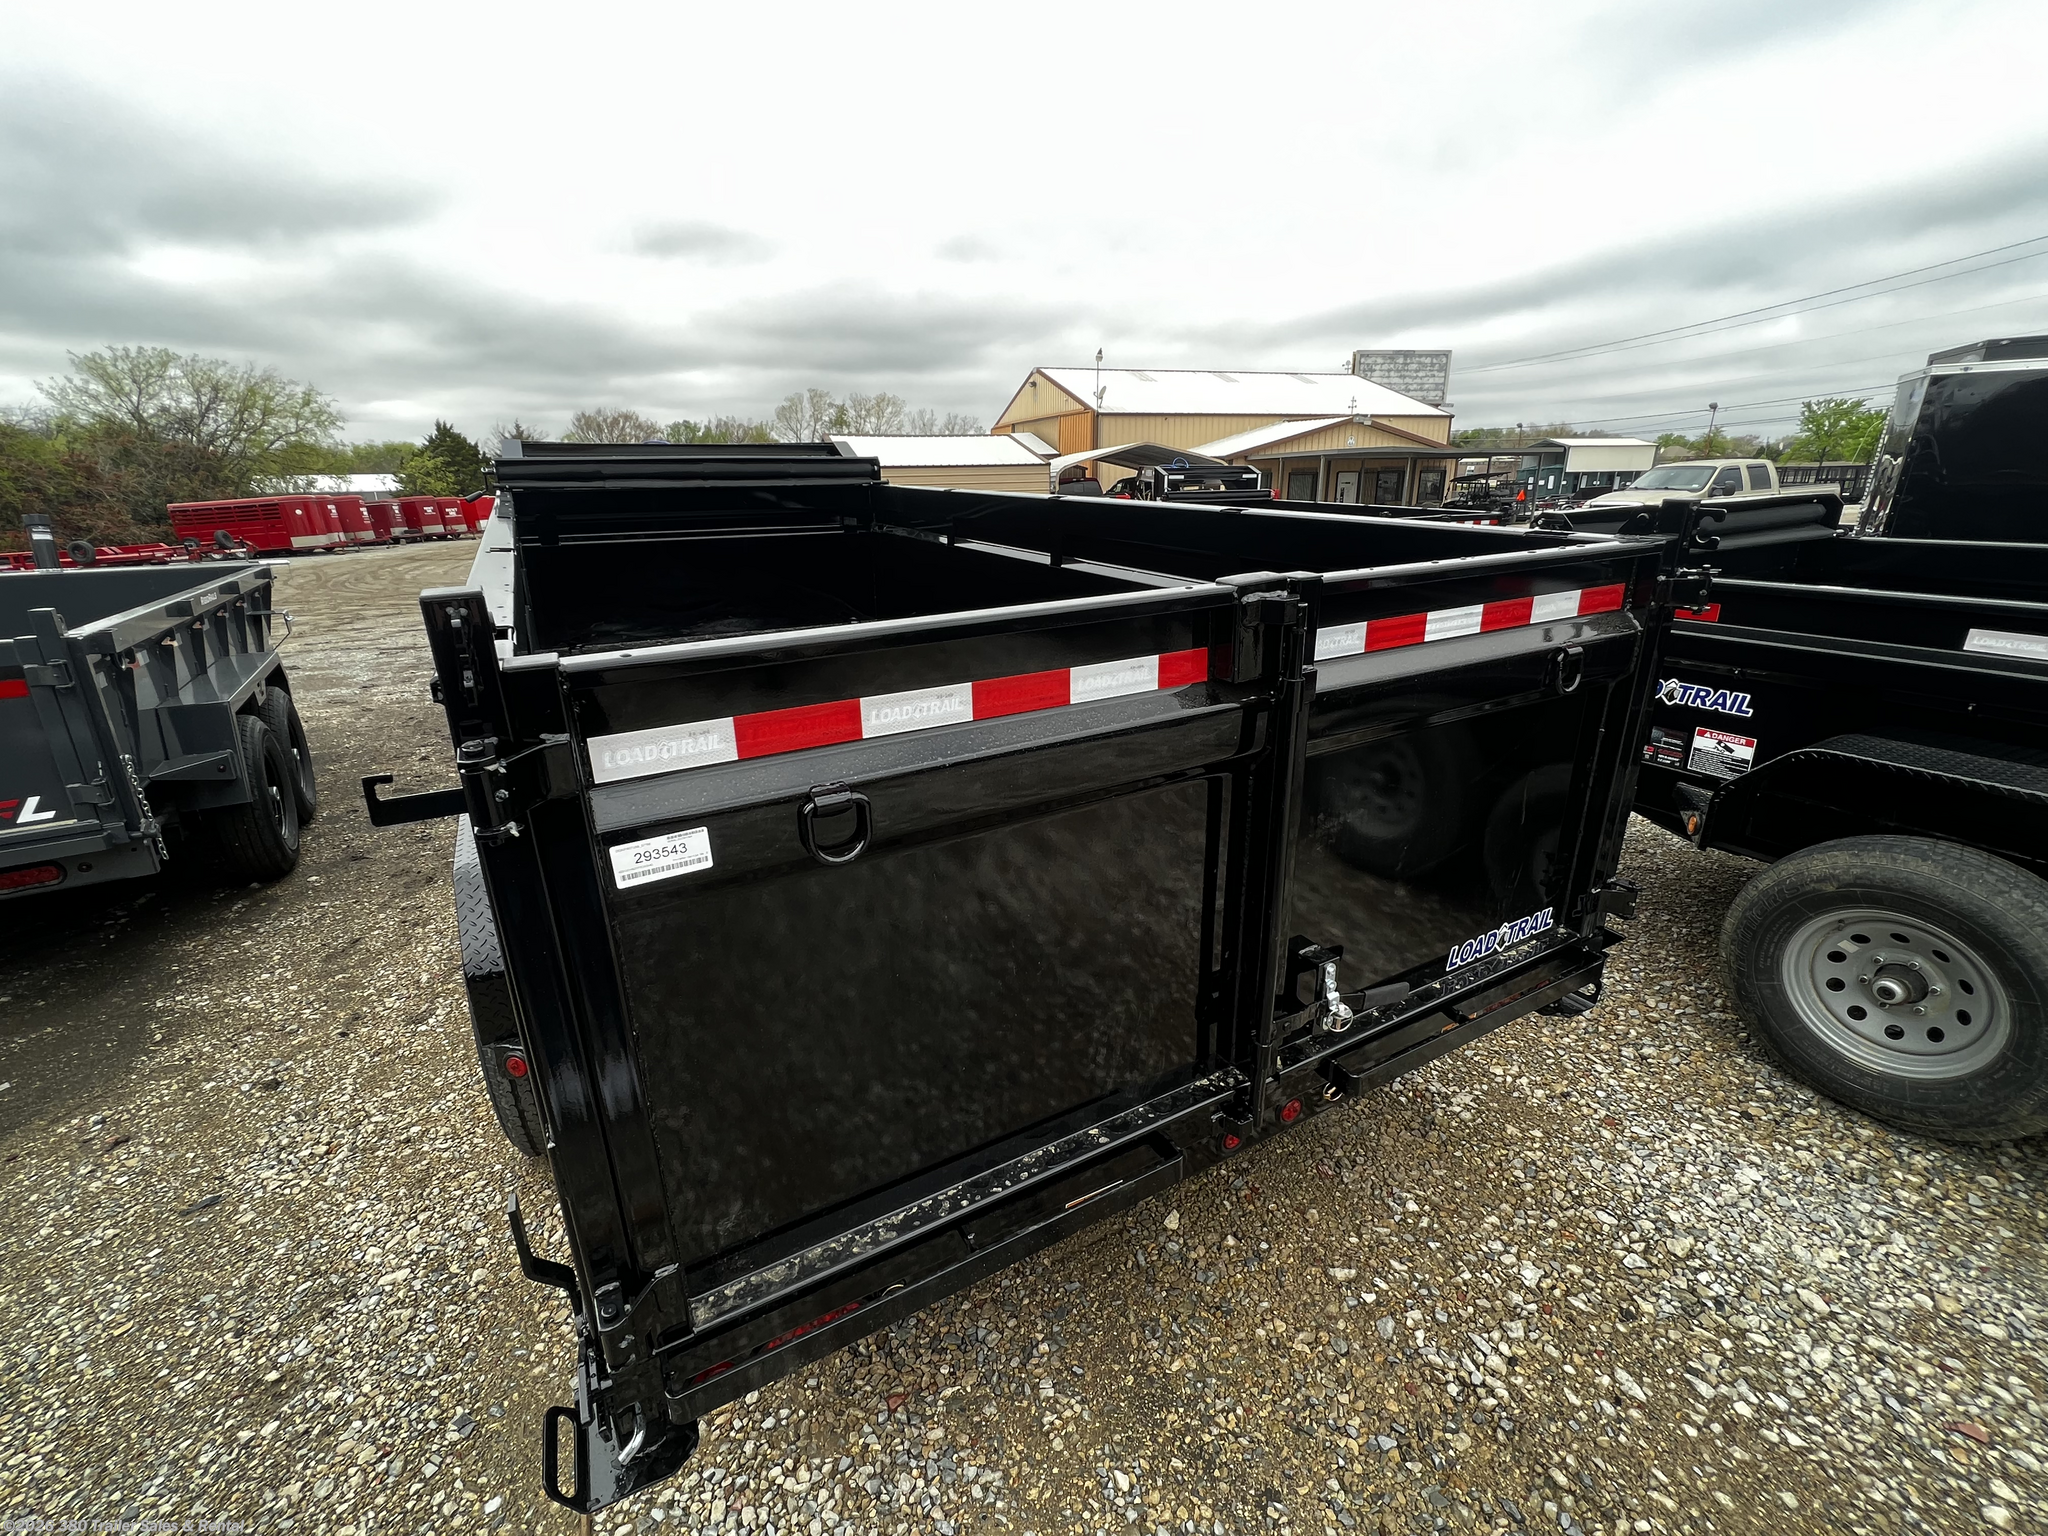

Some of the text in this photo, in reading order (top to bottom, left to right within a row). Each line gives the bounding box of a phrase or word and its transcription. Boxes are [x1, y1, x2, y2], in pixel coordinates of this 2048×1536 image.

[870, 697, 965, 725] LOAD TRAIL
[1677, 683, 1753, 717] TRAIL
[602, 733, 724, 769] LOAD TRAIL
[1711, 733, 1747, 745] DANGER
[633, 842, 688, 864] 293543
[1446, 907, 1554, 971] LOAD TRAIL
